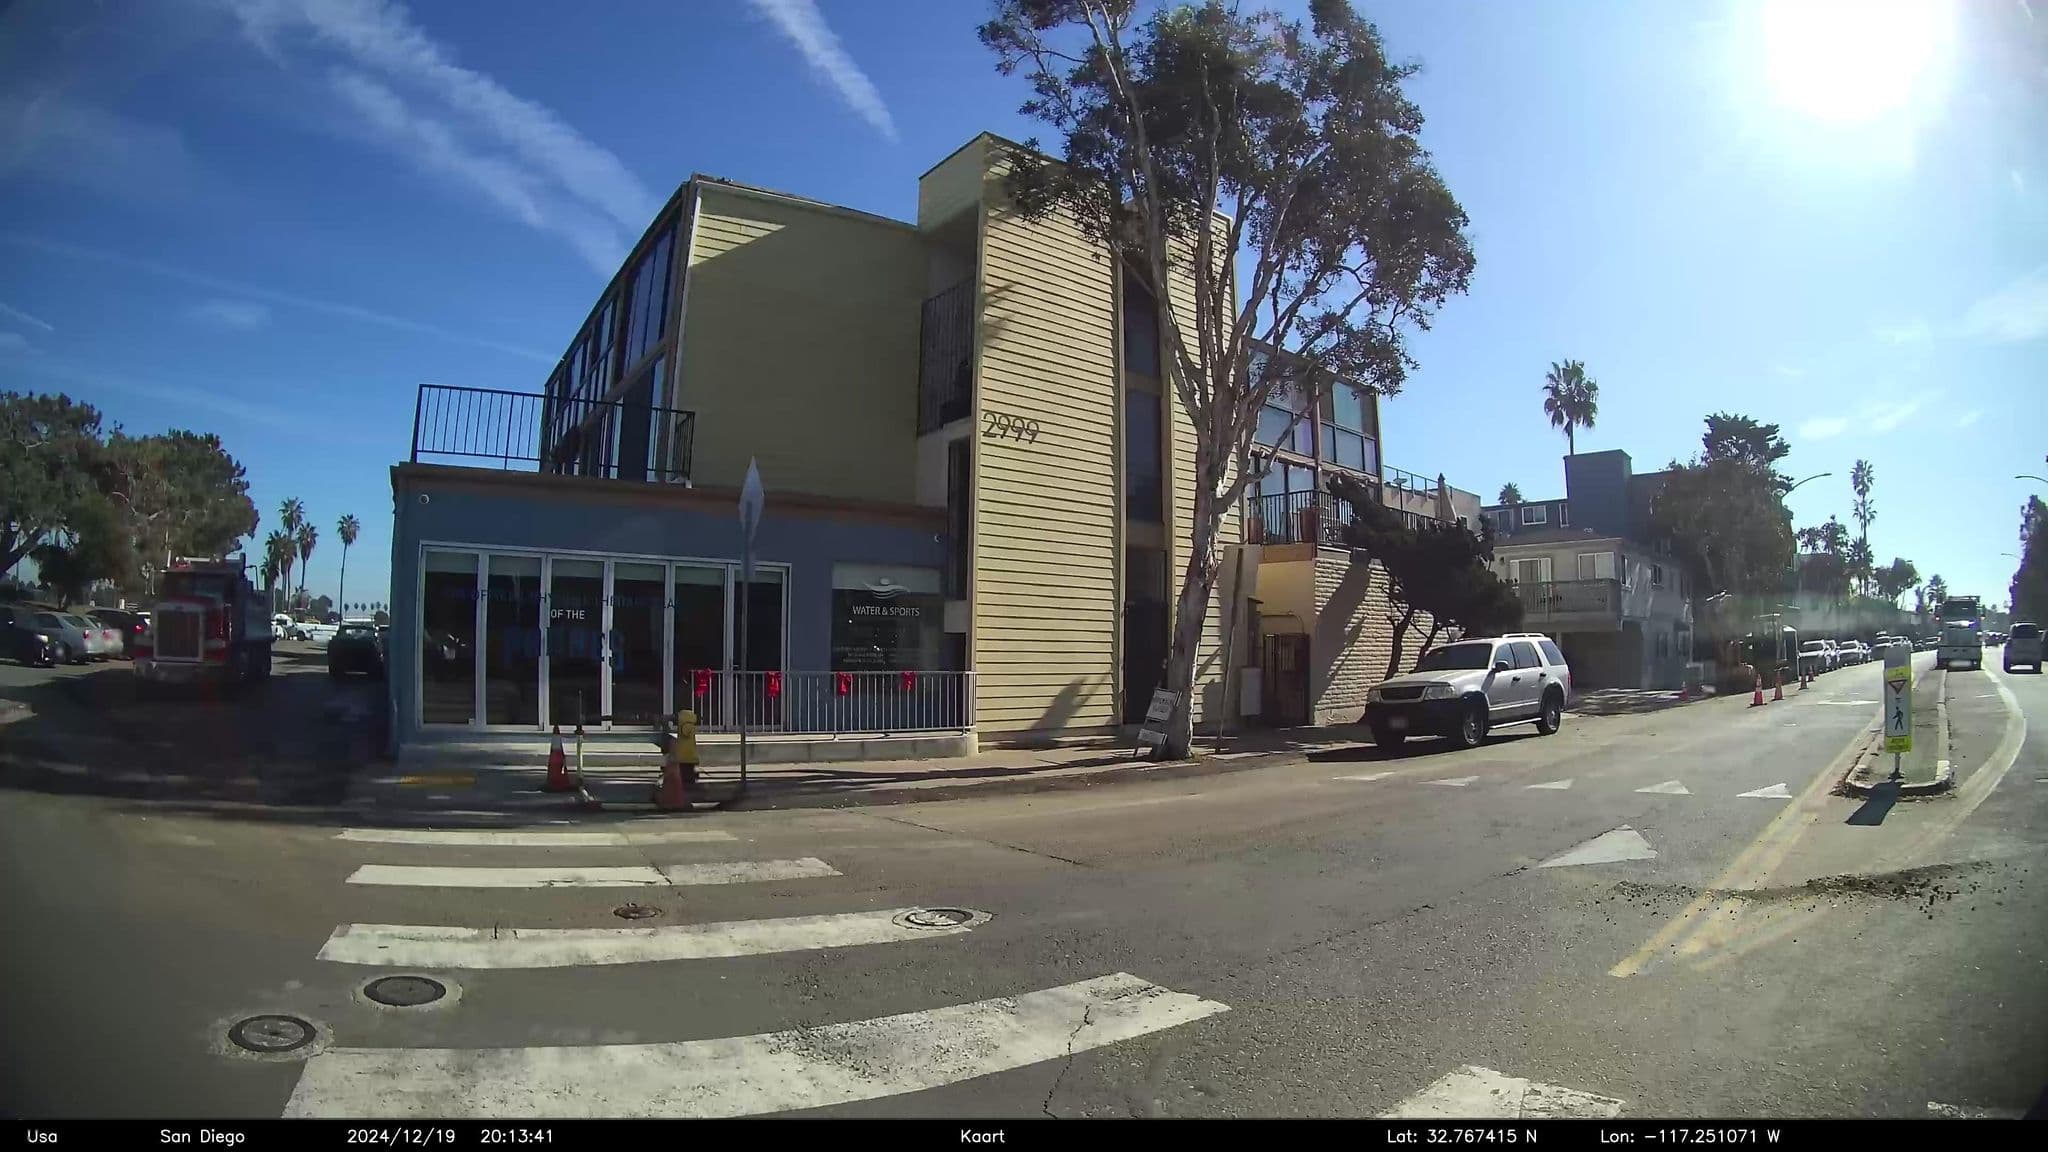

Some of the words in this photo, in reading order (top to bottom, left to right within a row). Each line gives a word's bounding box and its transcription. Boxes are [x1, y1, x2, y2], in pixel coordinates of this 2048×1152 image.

[983, 412, 1039, 444] 2999
[550, 608, 564, 619] OF
[565, 609, 585, 620] THE
[852, 605, 881, 616] WATER
[881, 606, 889, 616] &
[889, 606, 920, 617] SPORTS
